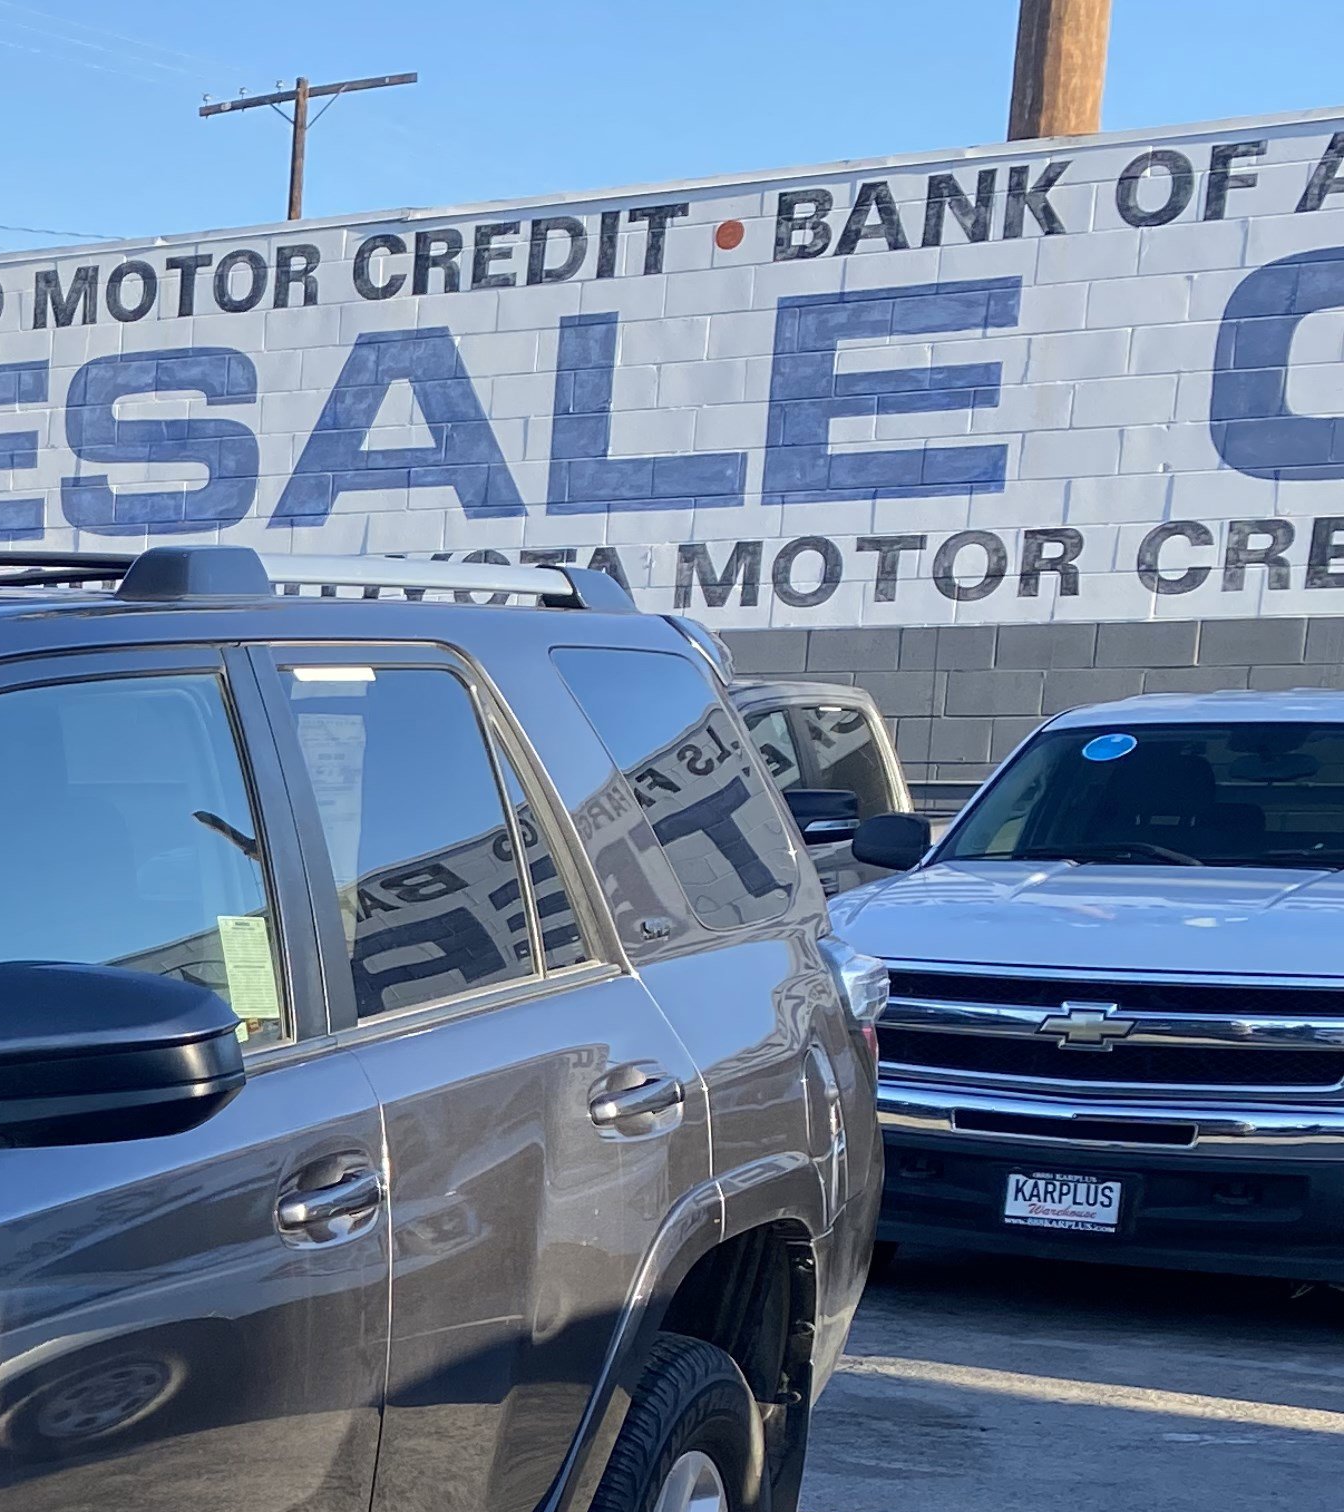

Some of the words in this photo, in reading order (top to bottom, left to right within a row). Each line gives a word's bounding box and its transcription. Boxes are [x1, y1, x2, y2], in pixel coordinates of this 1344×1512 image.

[33, 242, 322, 330] MOTOR
[352, 202, 690, 300] CREDIT
[773, 160, 1075, 262] BANK
[1115, 140, 1269, 228] OF
[673, 527, 1085, 610] MOTOR
[1013, 1178, 1115, 1209] KARPLUS
